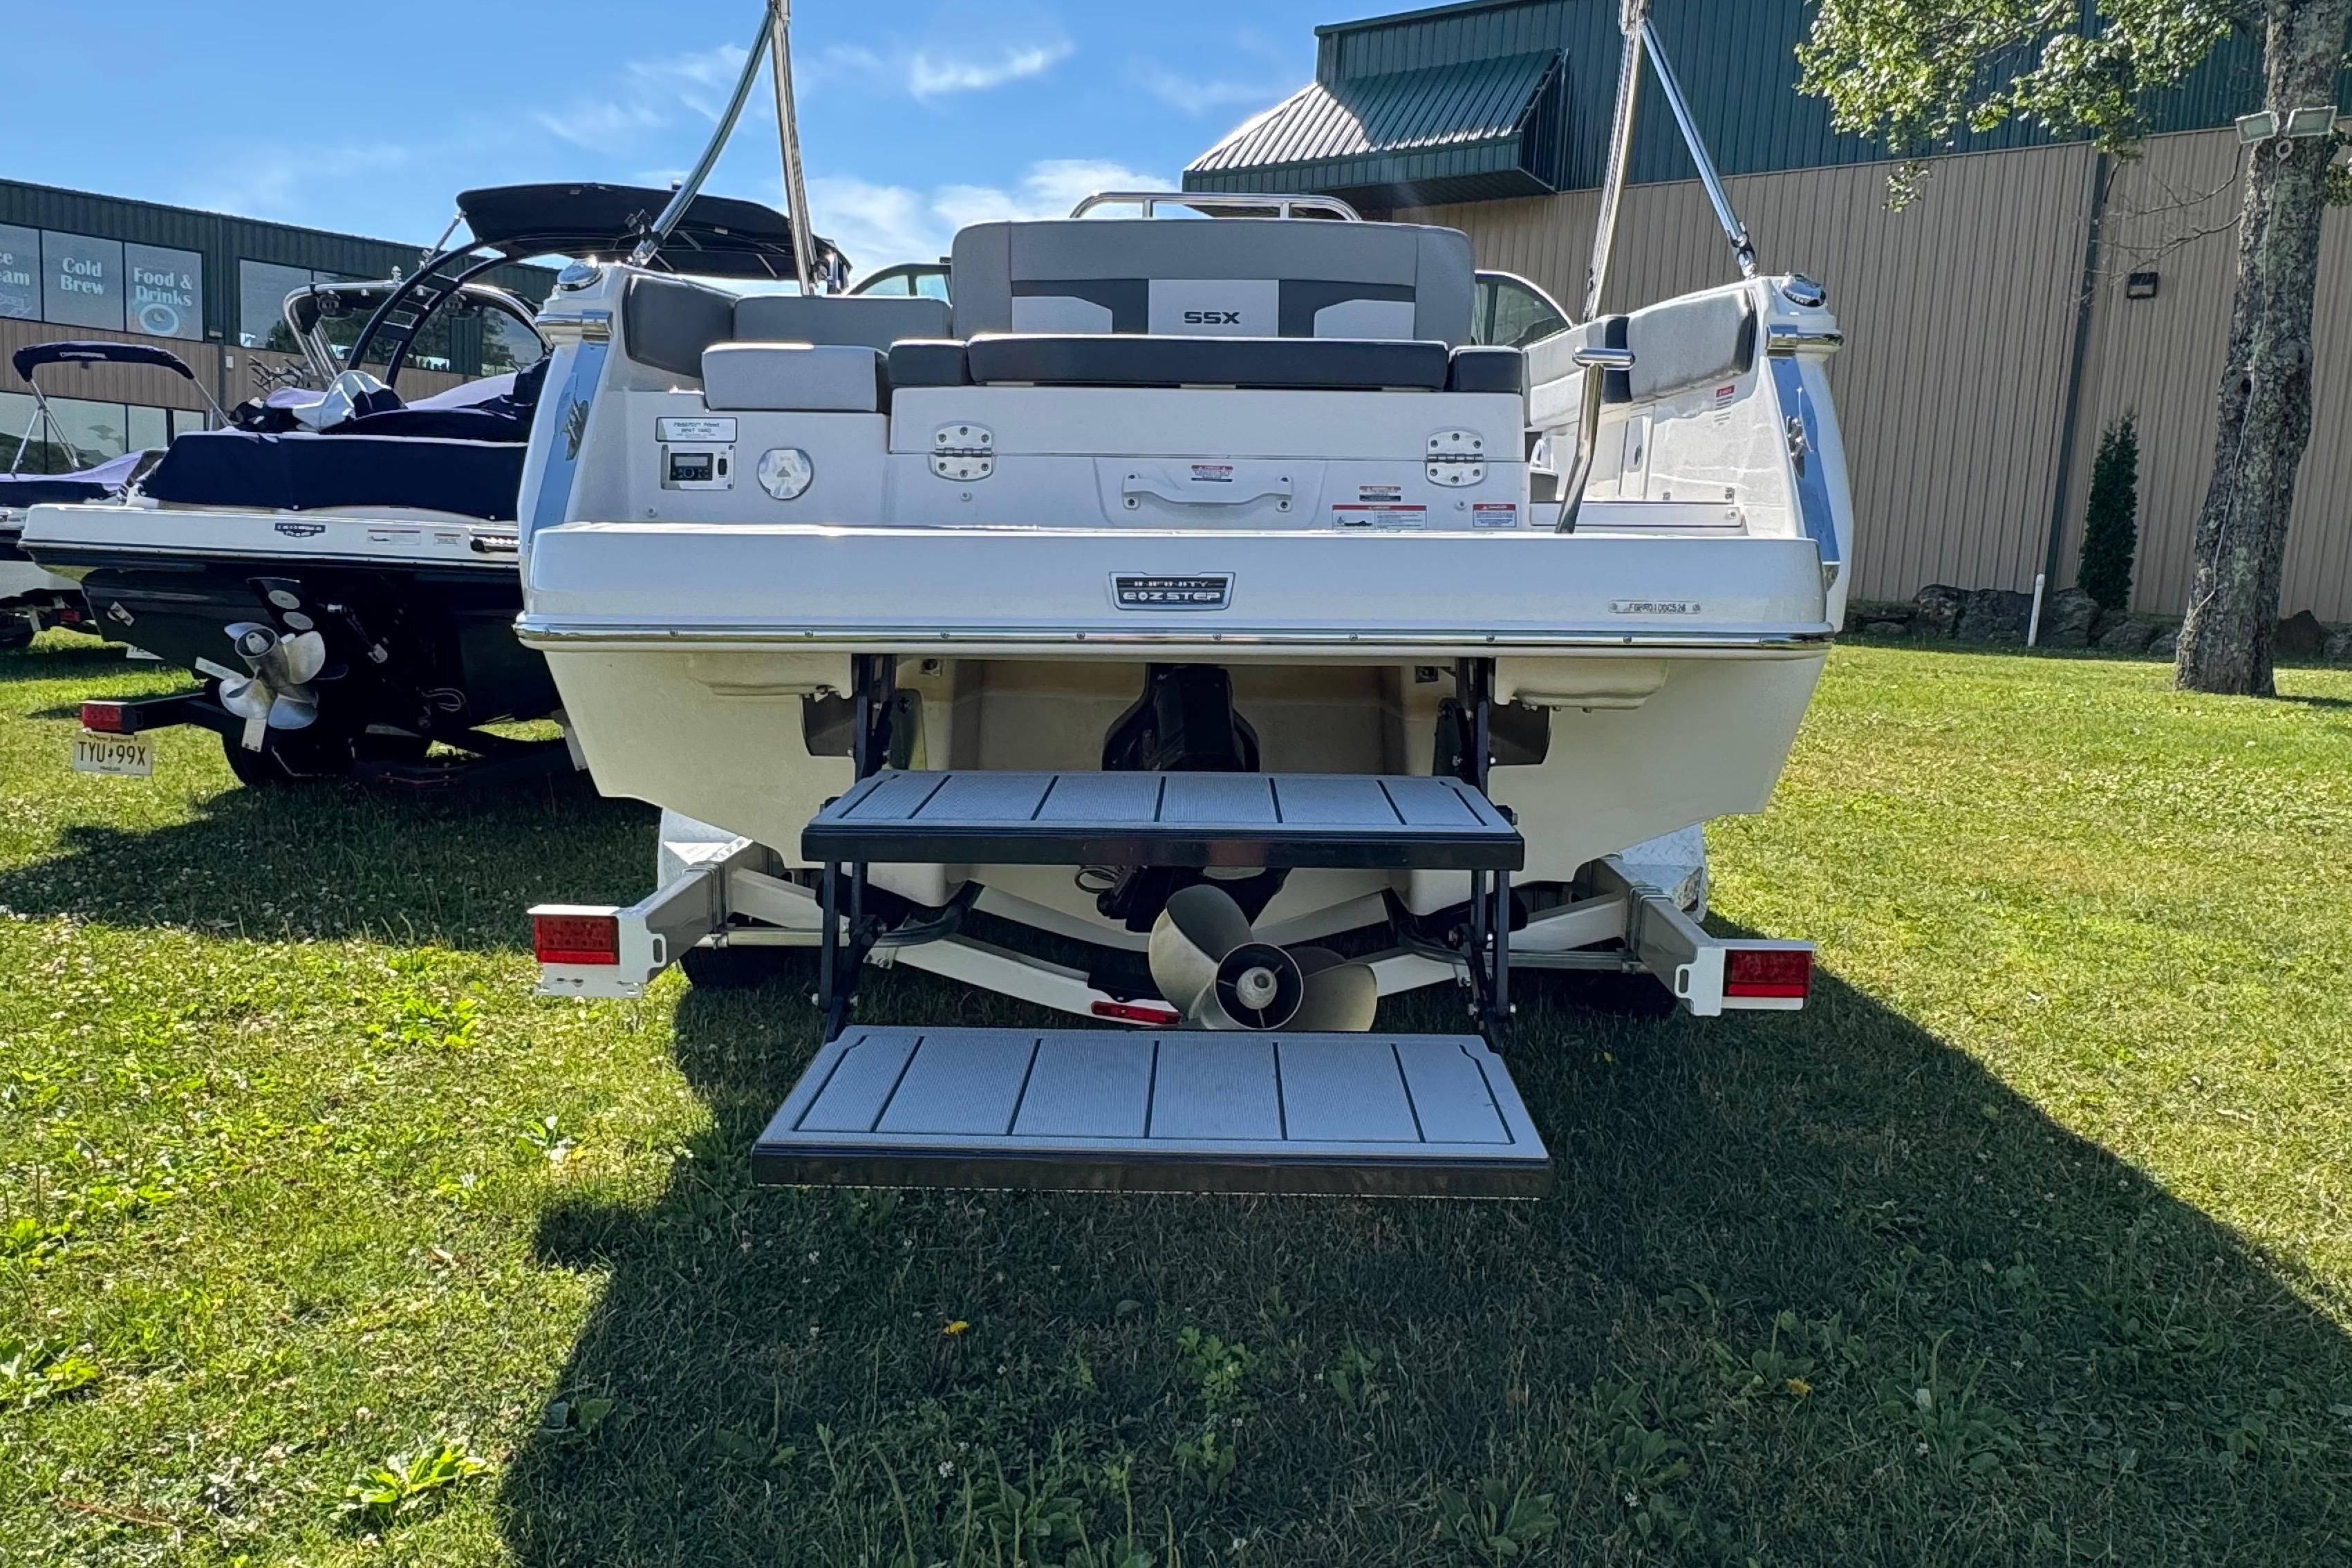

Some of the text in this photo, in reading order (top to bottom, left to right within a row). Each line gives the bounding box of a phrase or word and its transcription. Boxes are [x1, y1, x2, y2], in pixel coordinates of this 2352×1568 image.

[62, 256, 102, 277] Cold
[0, 270, 30, 286] am
[60, 274, 104, 295] Brew
[133, 267, 193, 290] Food &
[135, 285, 192, 307] Drinks
[1184, 311, 1240, 324] SSX
